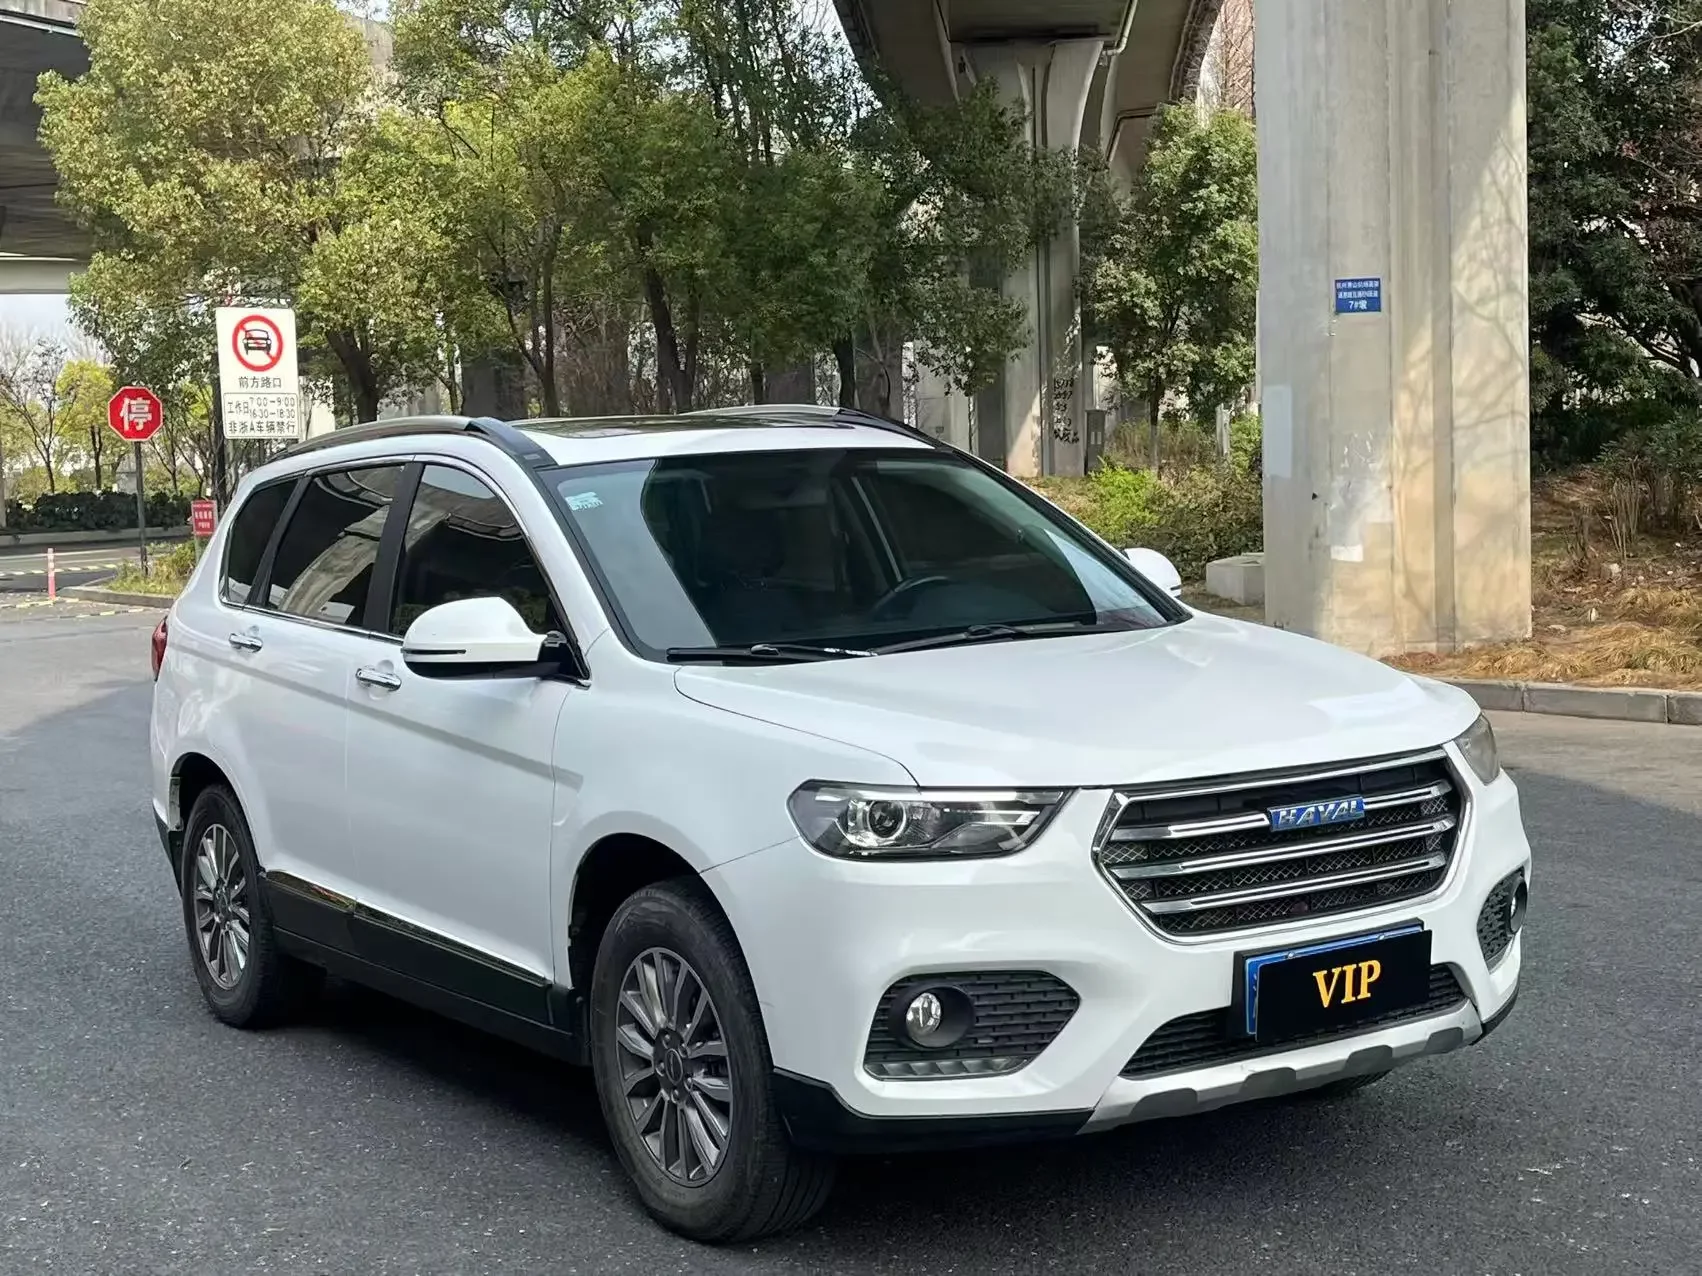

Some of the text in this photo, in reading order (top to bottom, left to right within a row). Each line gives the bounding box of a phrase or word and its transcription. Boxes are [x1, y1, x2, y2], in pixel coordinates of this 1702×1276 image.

[239, 376, 282, 389] 前方路口
[120, 396, 152, 431] 停
[228, 401, 249, 415] 工作日
[228, 420, 295, 434] 非浙A车辆禁行
[1278, 799, 1358, 825] HAVAL
[1312, 959, 1382, 1008] VIP
